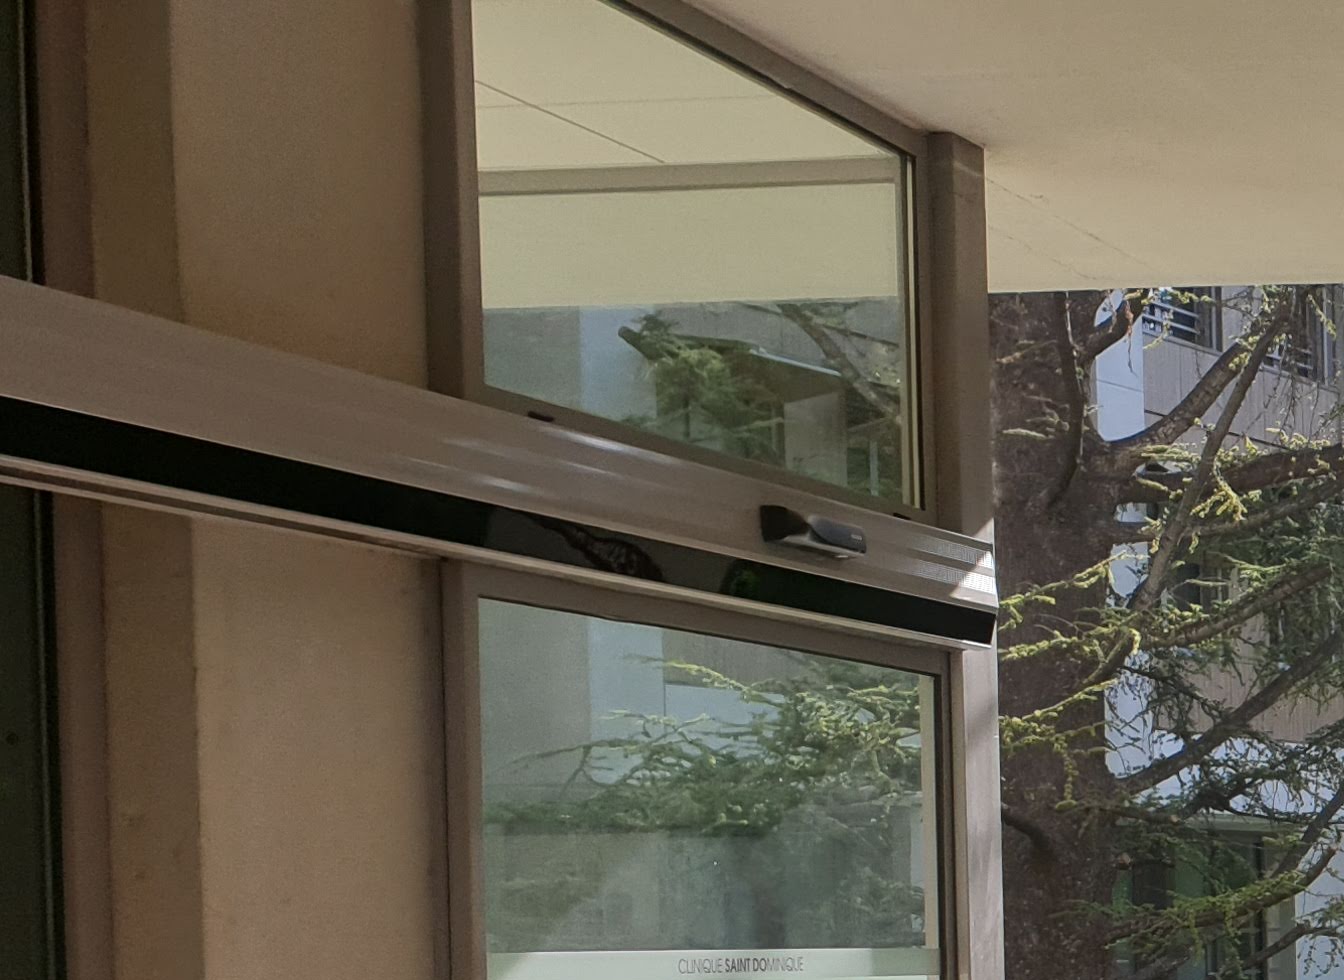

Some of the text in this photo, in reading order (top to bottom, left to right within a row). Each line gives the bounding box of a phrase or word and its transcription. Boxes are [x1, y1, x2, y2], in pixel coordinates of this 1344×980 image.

[678, 956, 804, 975] CLINIQUE SAINT DOMINIQUE
